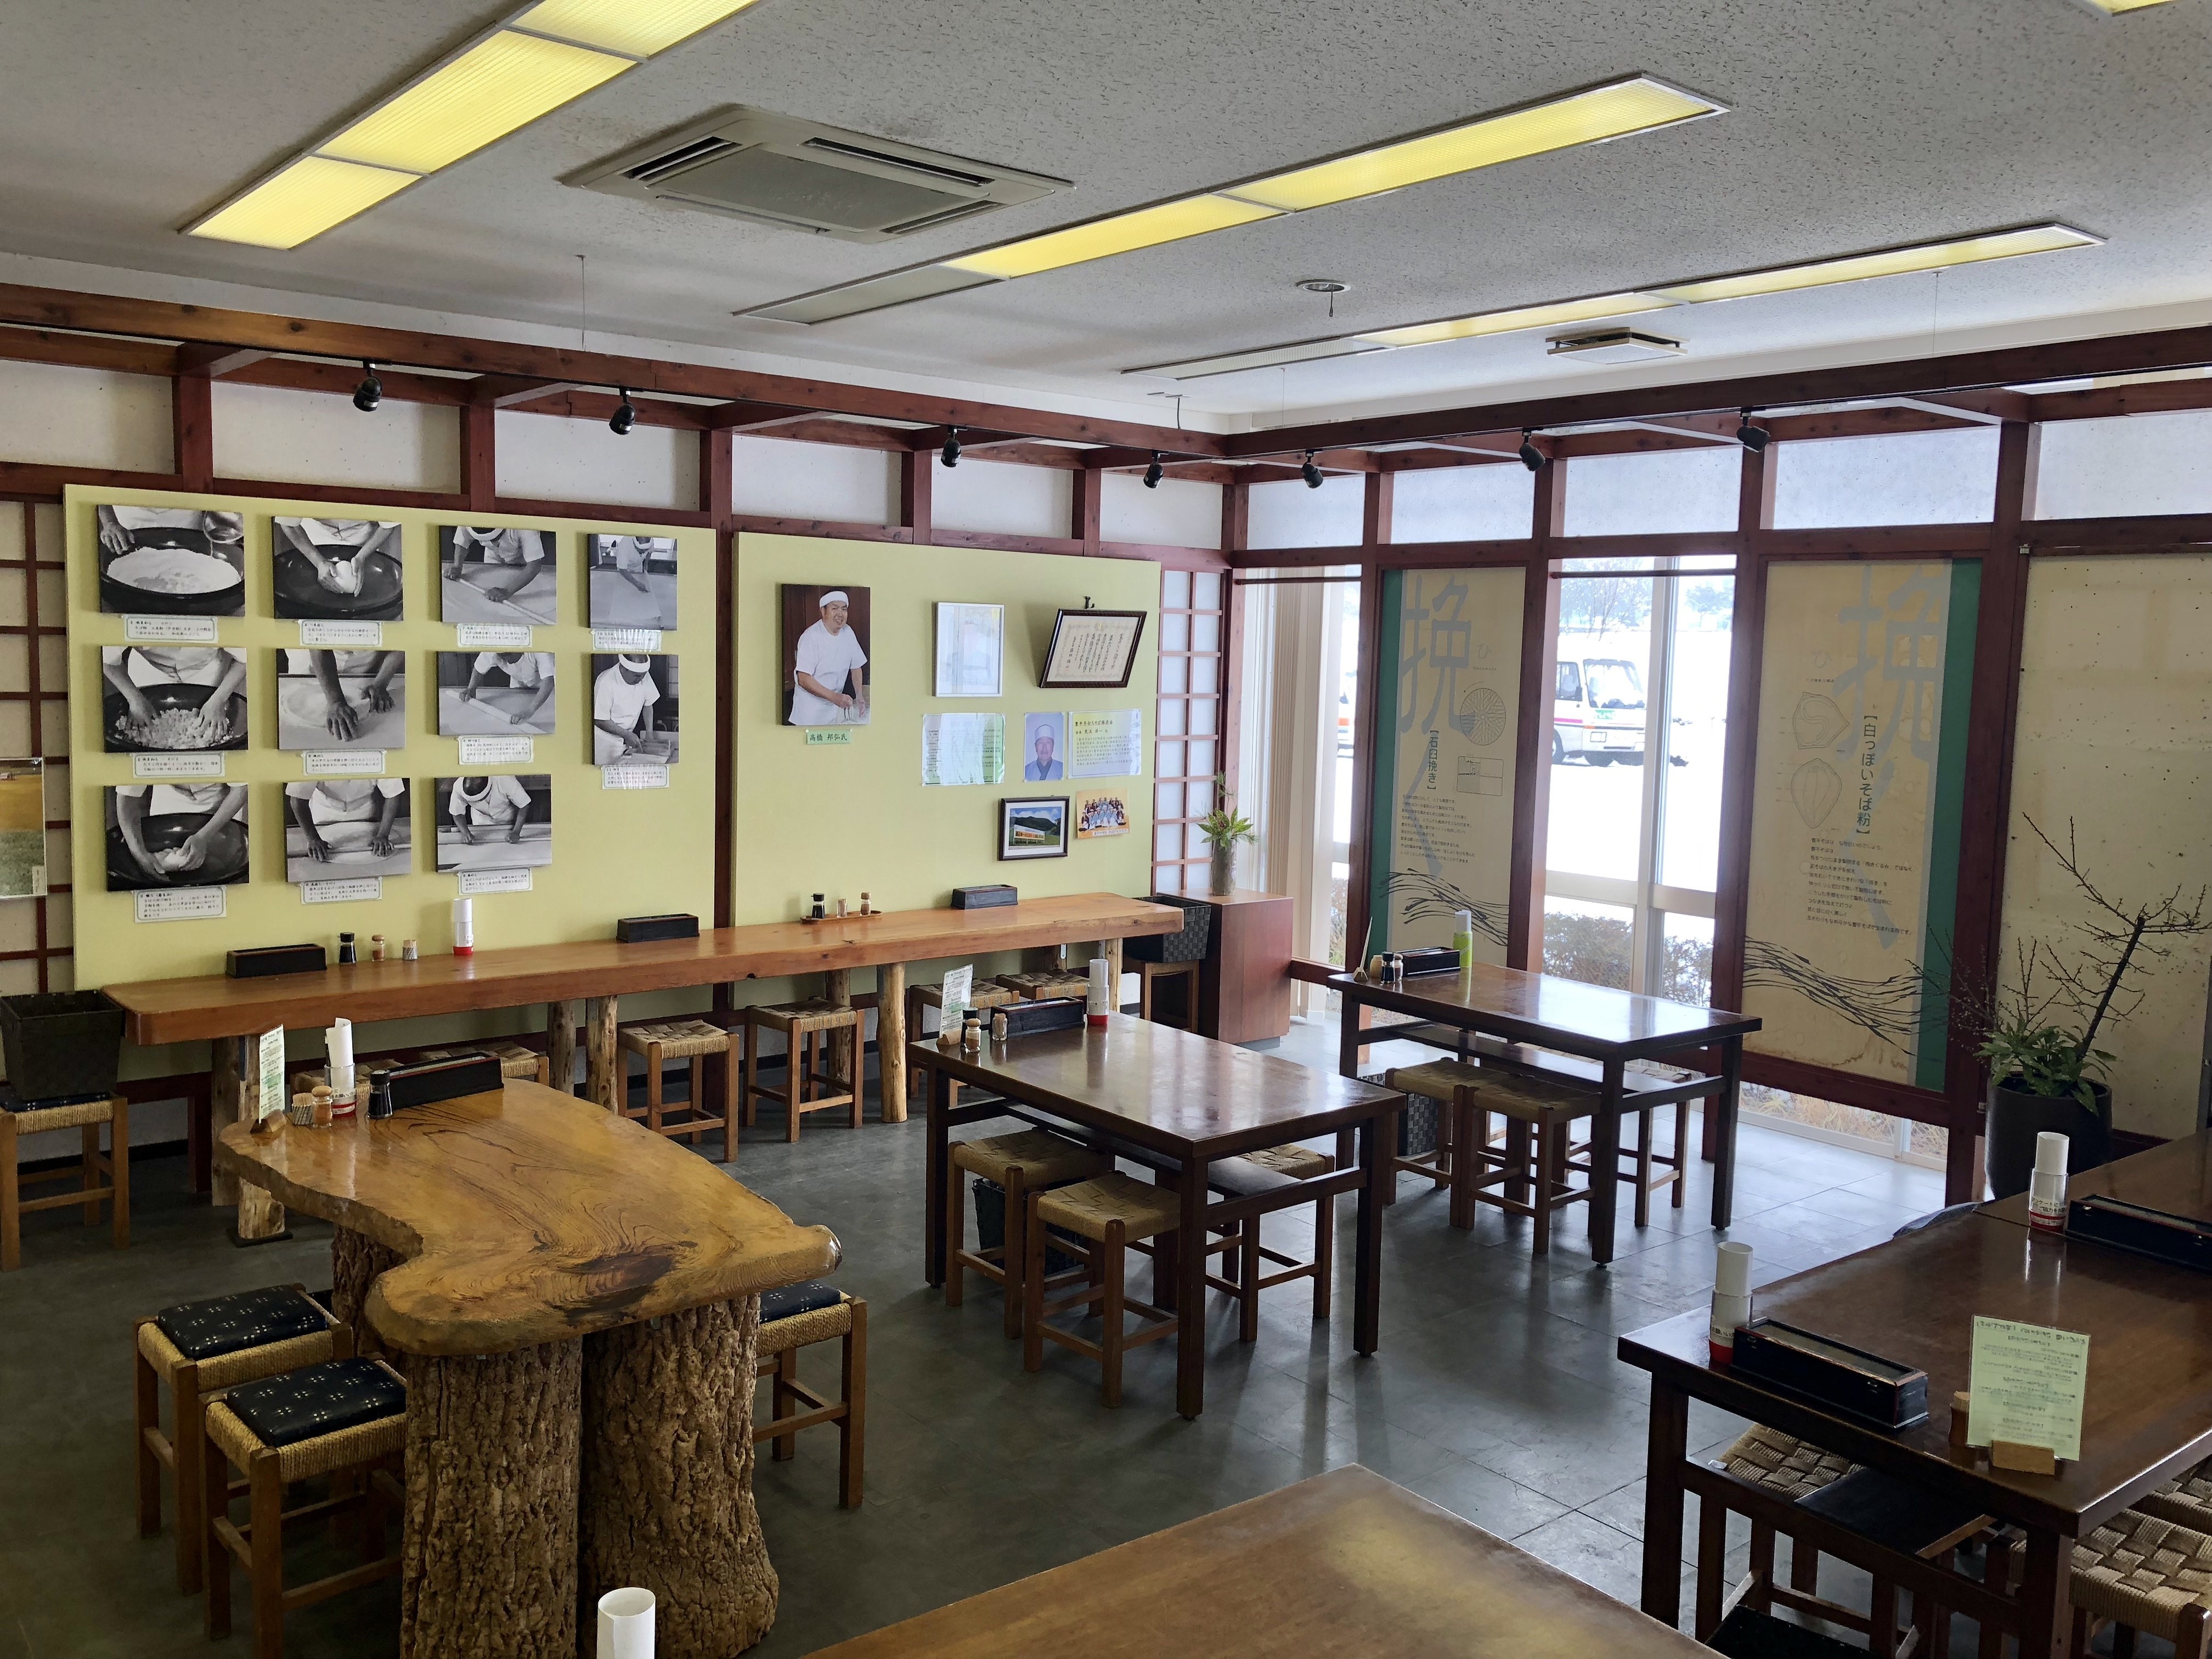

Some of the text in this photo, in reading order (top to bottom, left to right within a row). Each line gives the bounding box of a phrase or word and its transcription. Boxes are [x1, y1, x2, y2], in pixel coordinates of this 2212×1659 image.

[1427, 730, 1438, 791] 【石臼挽き】
[1857, 715, 1877, 834] 【白っぽいそば粉】
